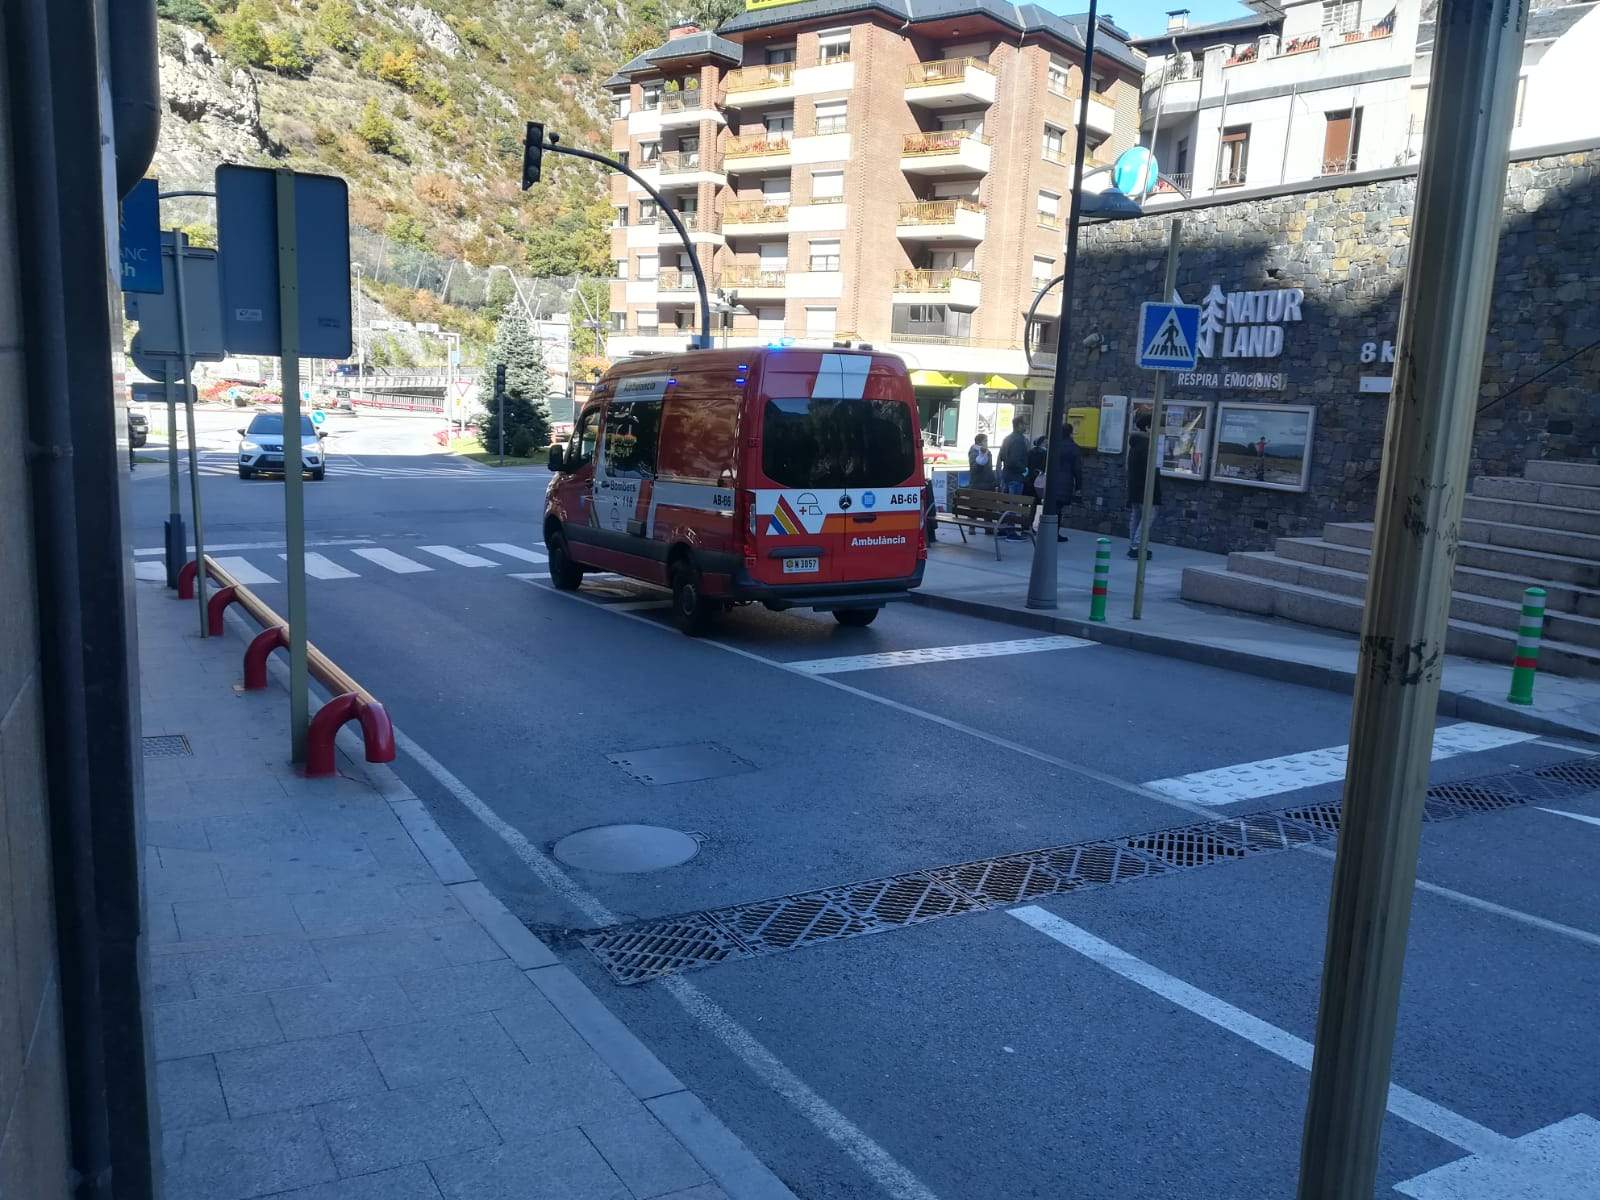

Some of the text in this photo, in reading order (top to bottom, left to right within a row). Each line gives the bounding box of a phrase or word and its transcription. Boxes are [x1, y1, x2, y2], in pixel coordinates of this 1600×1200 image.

[1225, 288, 1304, 323] NATUR
[1222, 325, 1284, 358] LAND
[1360, 340, 1397, 364] 8 k
[1178, 373, 1218, 387] RESPIRA
[890, 493, 918, 505] AB-66
[851, 535, 906, 547] Ambulància
